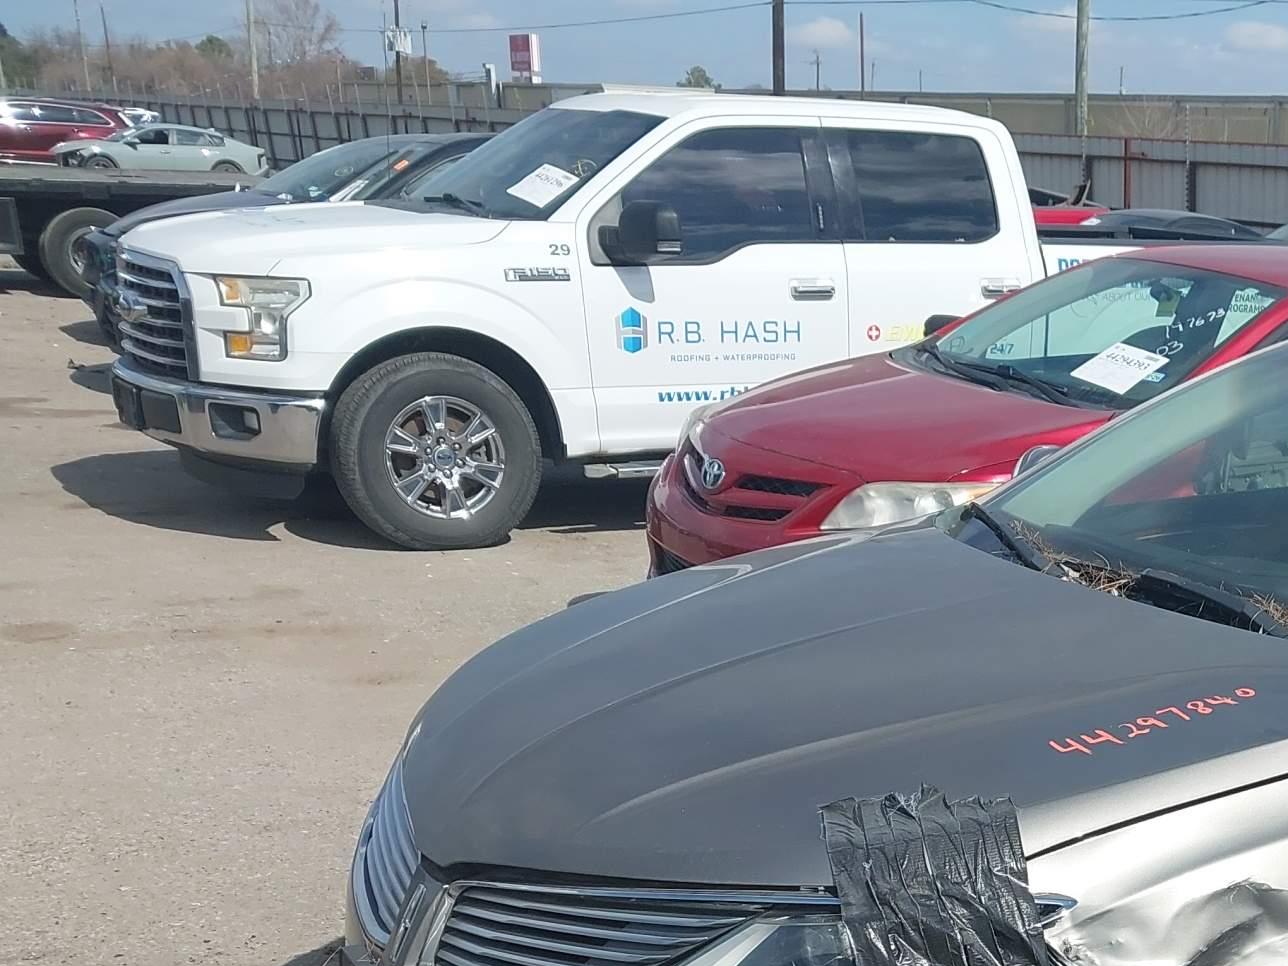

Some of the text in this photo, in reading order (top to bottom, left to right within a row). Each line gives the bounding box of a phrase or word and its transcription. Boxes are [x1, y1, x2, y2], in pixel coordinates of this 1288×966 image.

[548, 243, 571, 256] 29
[657, 320, 801, 344] R.B. HASH
[670, 354, 711, 362] ROOFING
[723, 353, 796, 361] WATERPROOFING
[1048, 687, 1256, 756] 44297840
